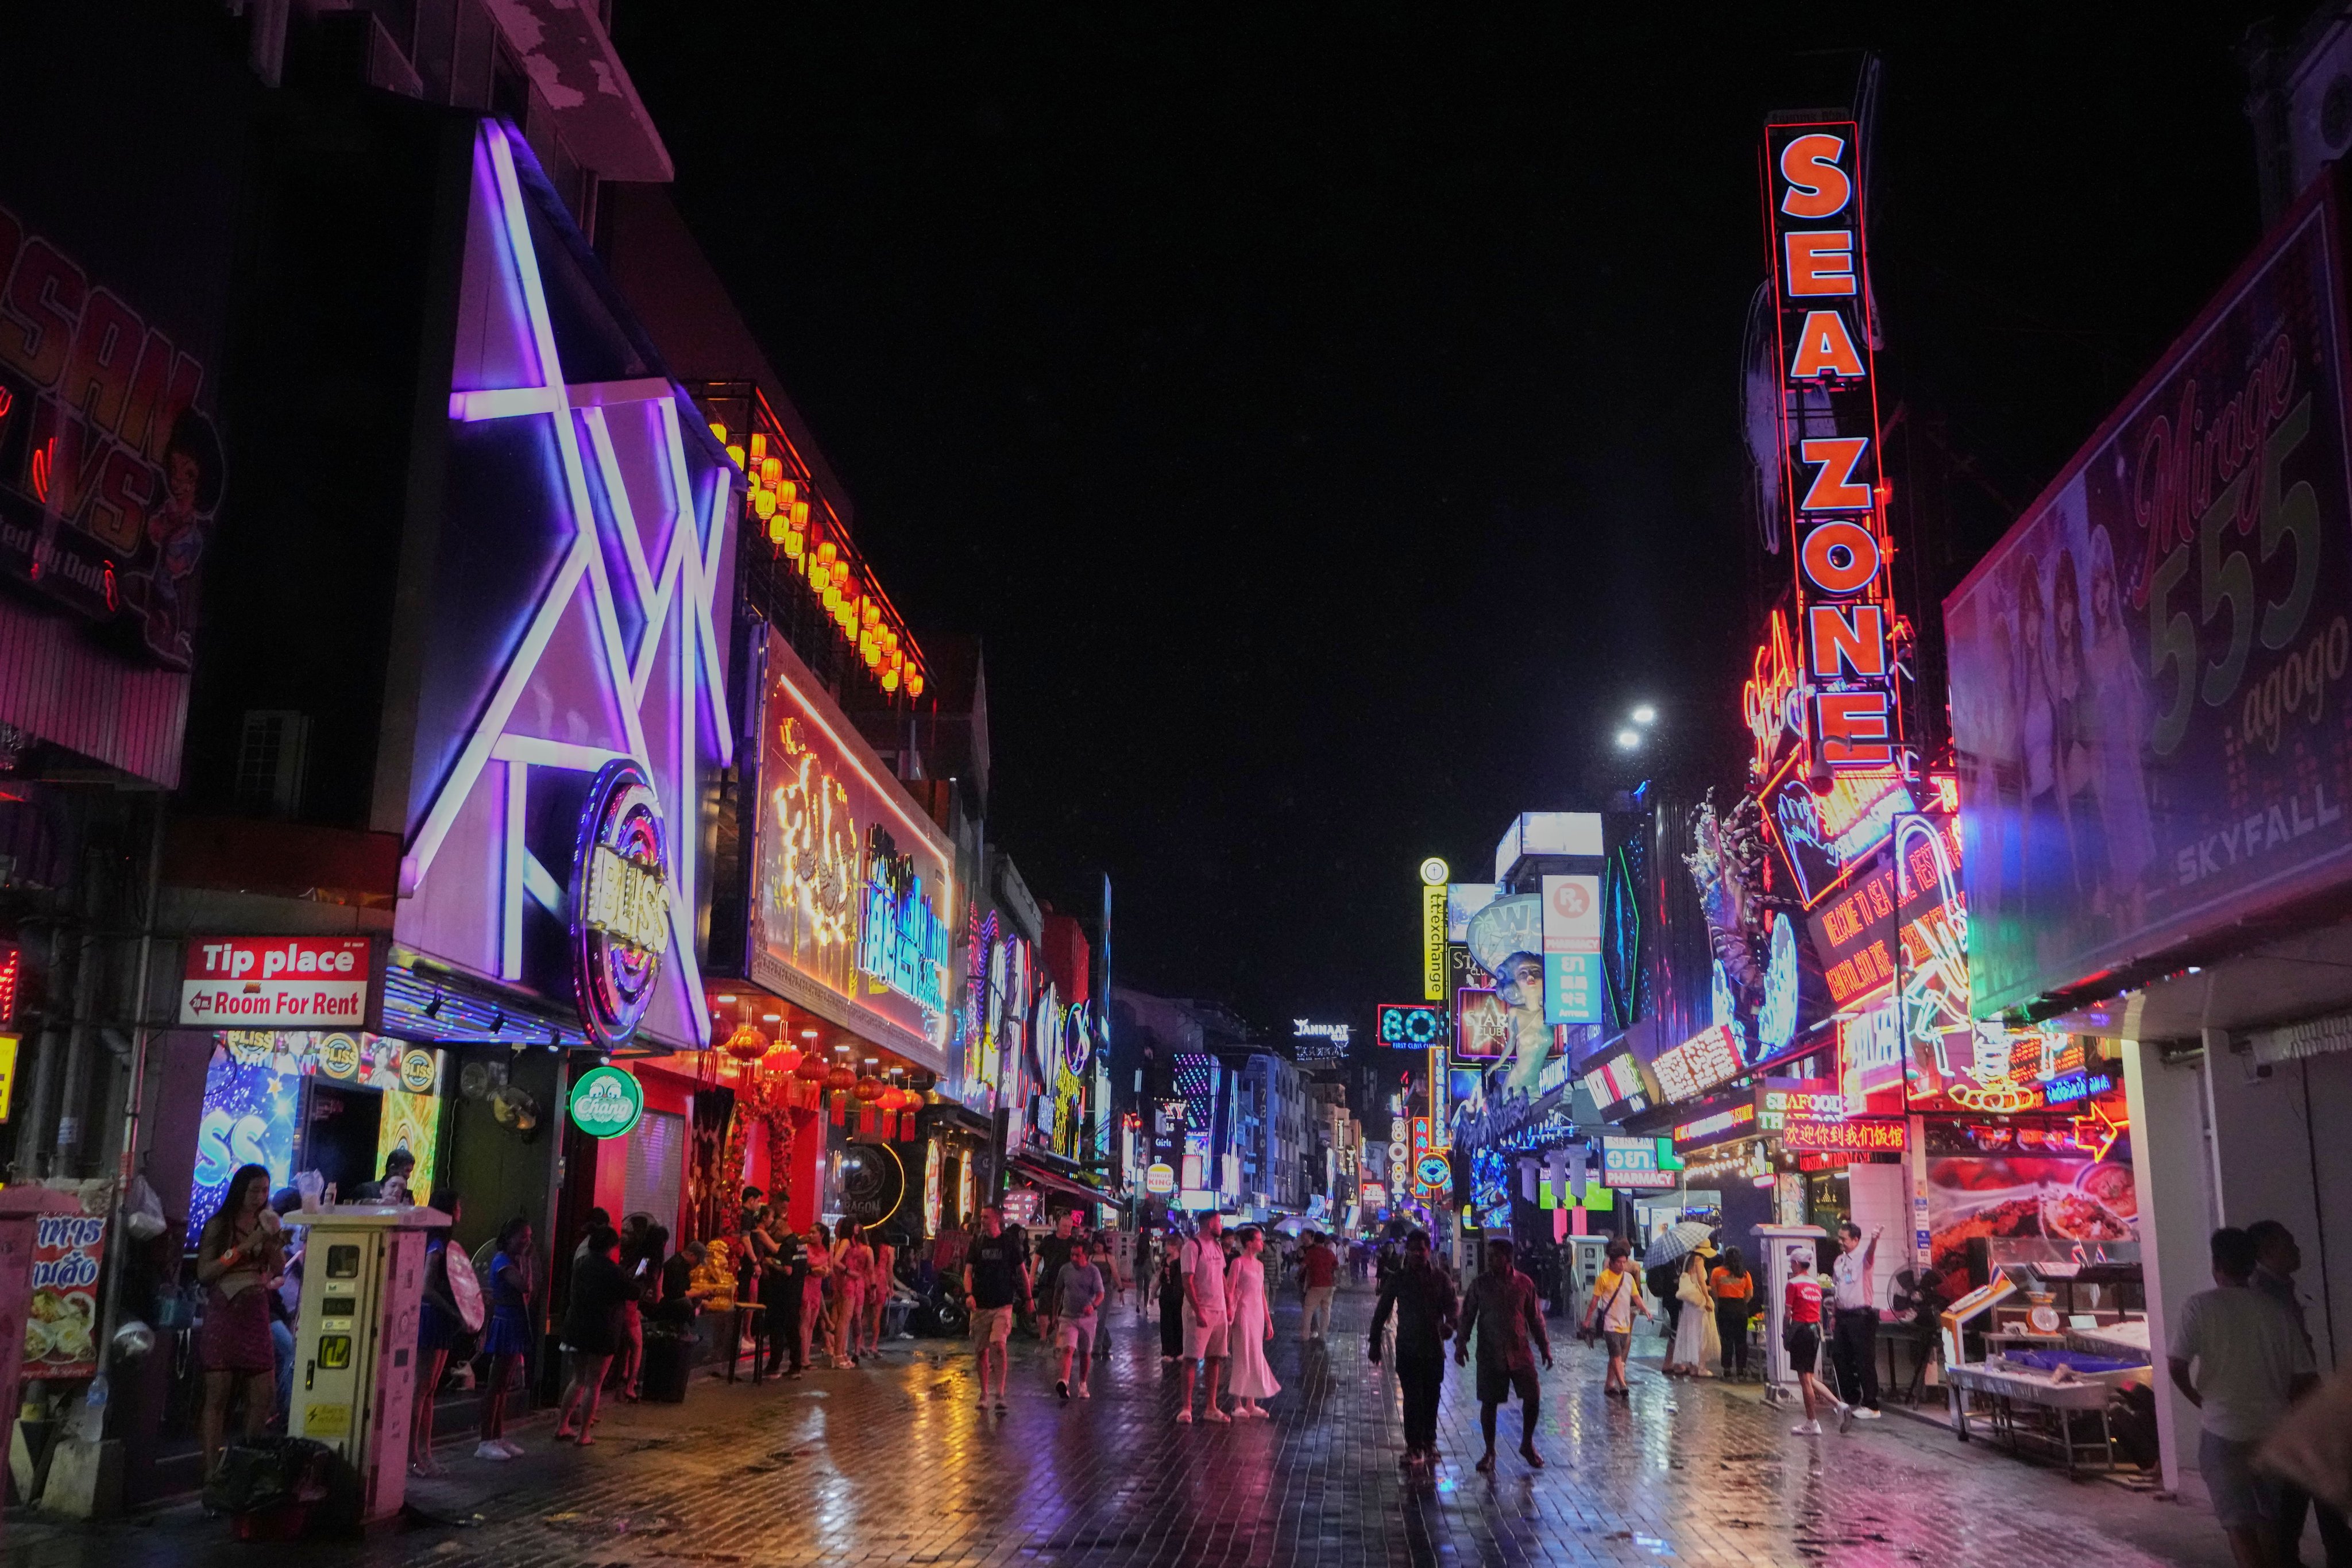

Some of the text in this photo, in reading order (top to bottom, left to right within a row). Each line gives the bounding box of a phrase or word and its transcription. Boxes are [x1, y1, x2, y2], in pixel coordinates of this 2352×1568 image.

[1781, 133, 1866, 379] SEA
[2150, 392, 2320, 755] 555
[1801, 437, 1893, 766] ZONE
[2177, 783, 2342, 886] SKYFALL
[589, 847, 670, 953] BLISS
[1867, 878, 1894, 918] SEA
[203, 944, 354, 978] Tip place
[1470, 967, 1488, 976] CLU
[214, 991, 358, 1015] Room For Rent
[321, 1044, 358, 1065] BLISS
[403, 1061, 433, 1079] BLISS
[577, 1097, 628, 1117] Chang
[1785, 1122, 1904, 1148] 欢迎你到我们饭馆
[1607, 1172, 1673, 1185] PHARMACY
